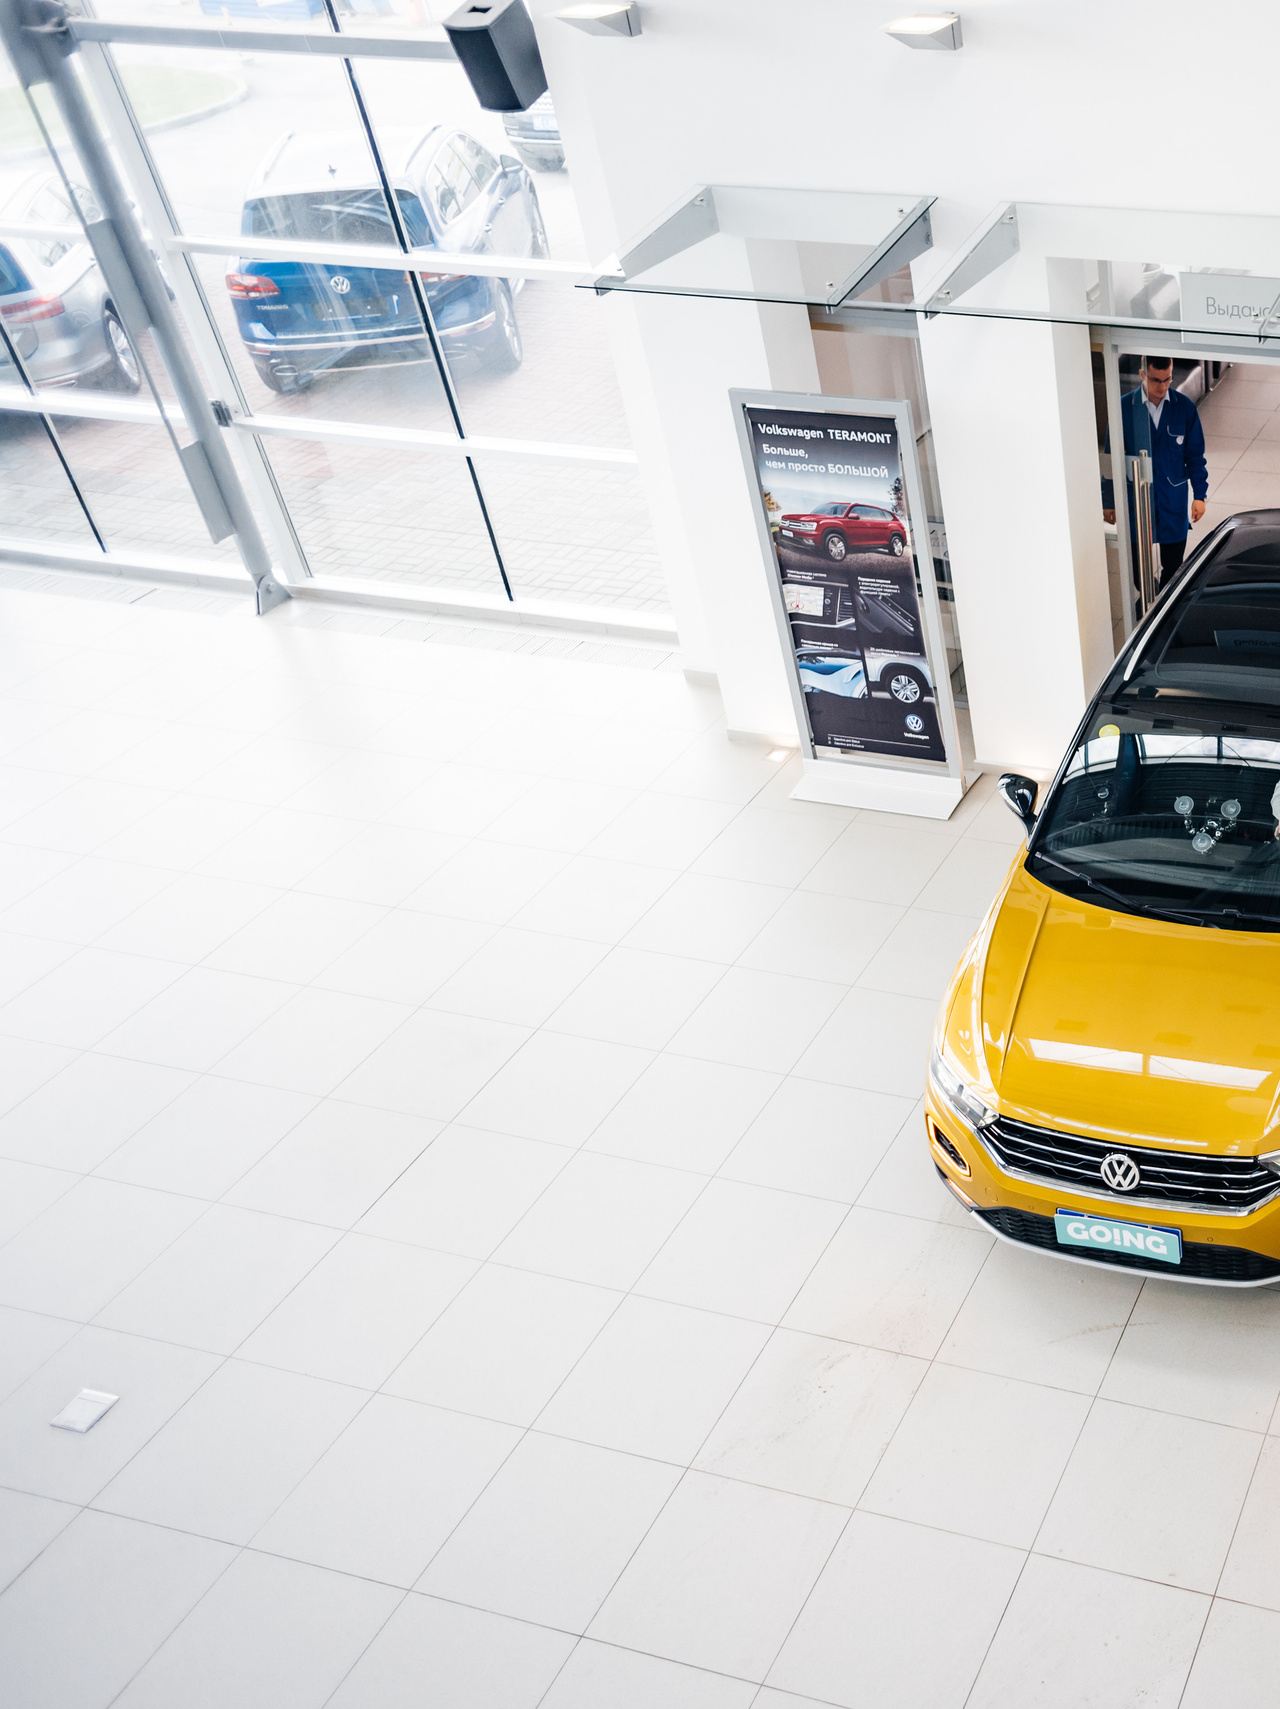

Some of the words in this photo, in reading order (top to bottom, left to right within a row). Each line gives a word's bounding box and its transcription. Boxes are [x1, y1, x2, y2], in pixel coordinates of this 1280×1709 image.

[758, 423, 824, 440] Volkswagen
[827, 428, 892, 444] TERAMONT
[762, 443, 809, 459] Больше,
[765, 459, 786, 470] чем
[788, 461, 826, 475] просто
[828, 463, 889, 479] БОЛЬШОЙ
